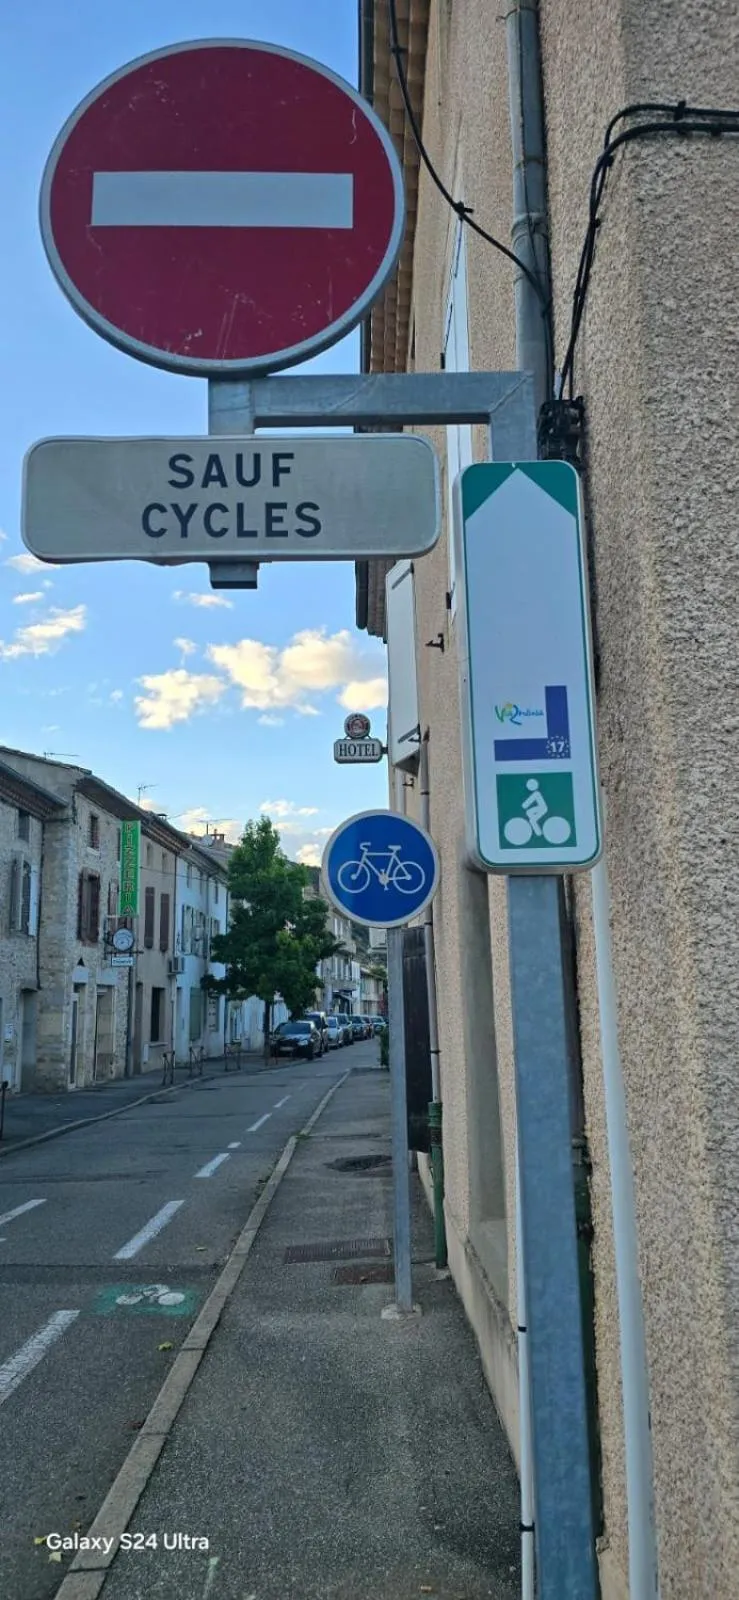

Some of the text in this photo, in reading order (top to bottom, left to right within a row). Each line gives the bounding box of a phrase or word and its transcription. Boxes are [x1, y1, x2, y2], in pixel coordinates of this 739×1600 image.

[168, 453, 295, 489] SAUF
[141, 501, 322, 539] CYCLES
[339, 743, 379, 757] HOTEL
[550, 741, 565, 753] 17
[123, 822, 136, 913] PIZZERIA
